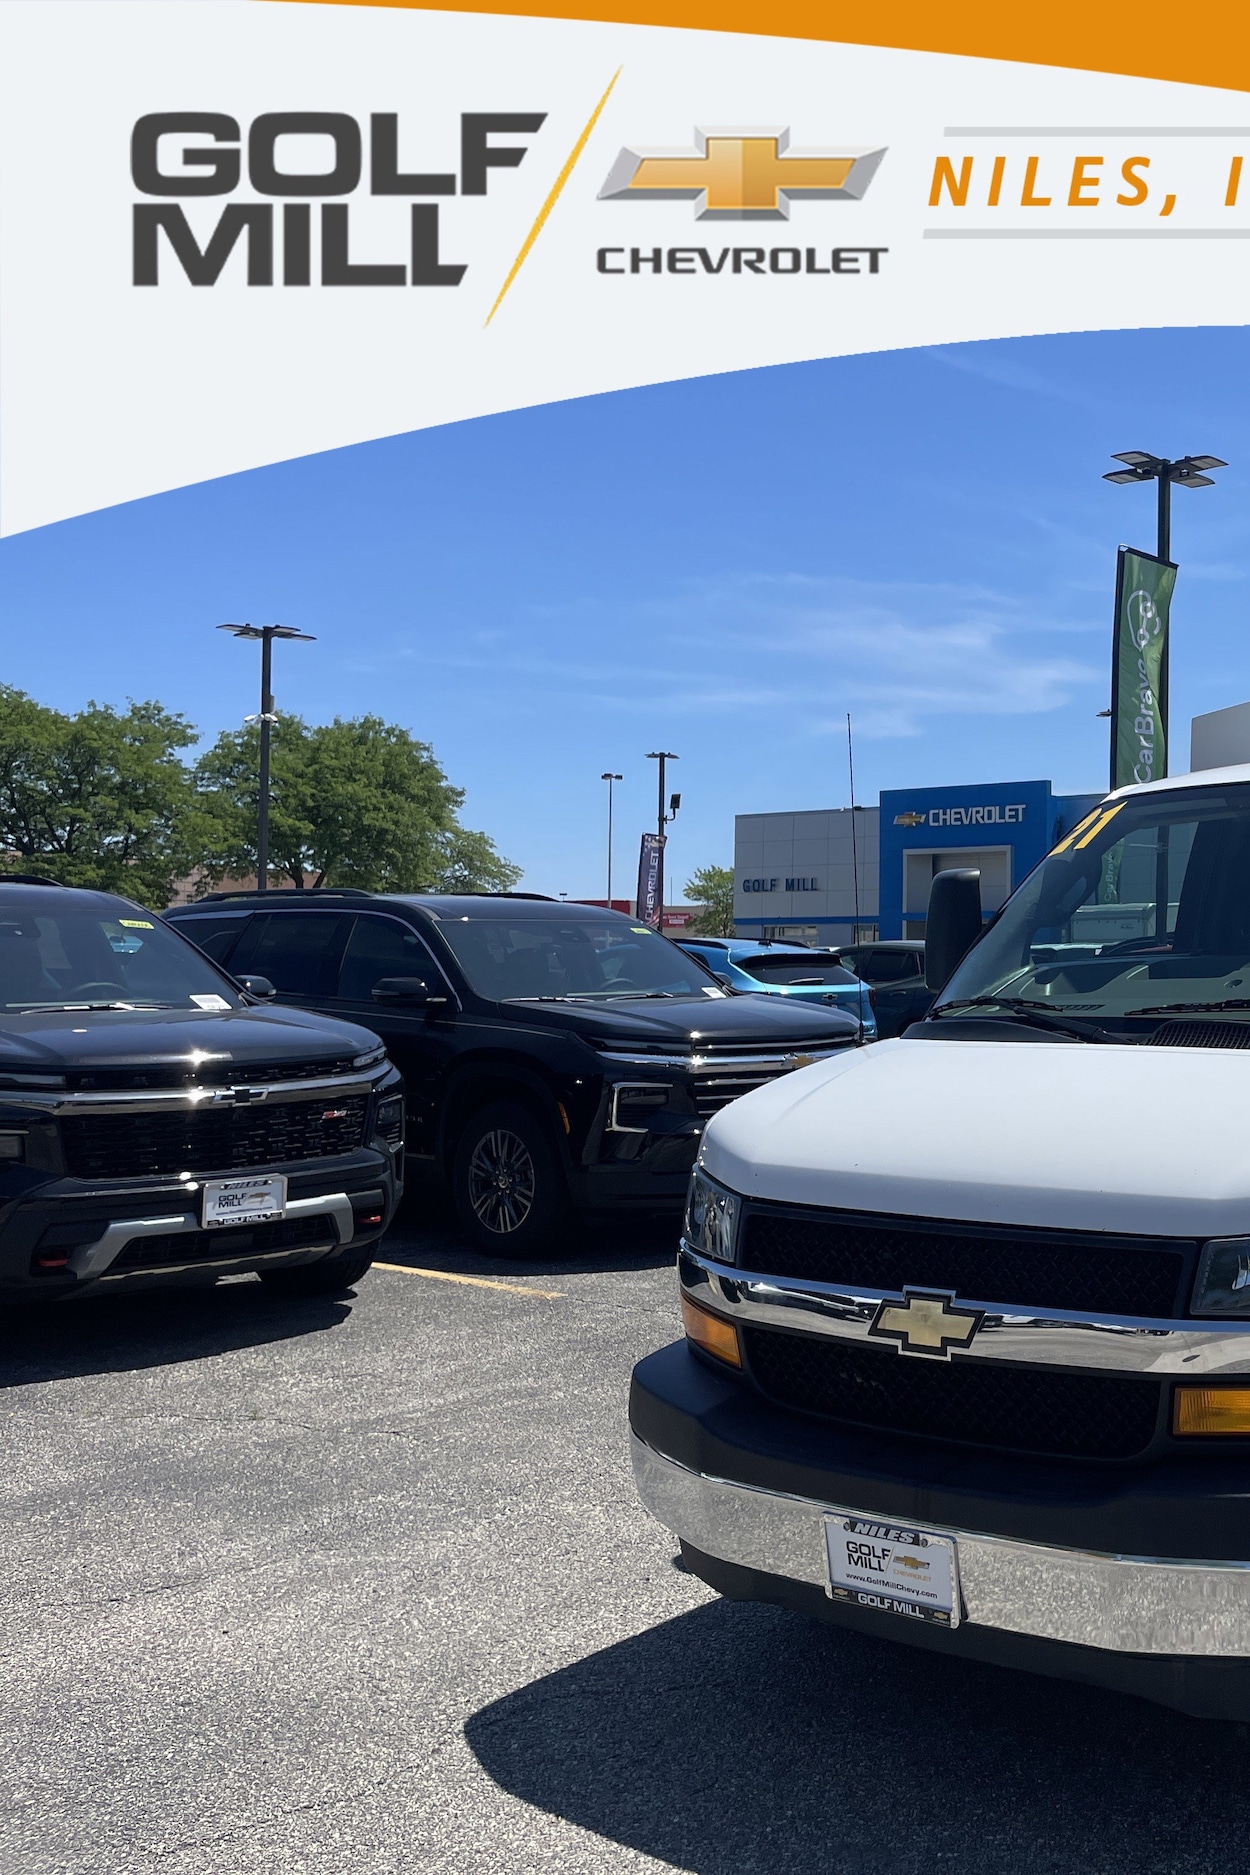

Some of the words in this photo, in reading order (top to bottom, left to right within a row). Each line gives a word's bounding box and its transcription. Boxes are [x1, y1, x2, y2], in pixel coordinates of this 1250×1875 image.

[928, 804, 1027, 827] CHEVROLET
[1046, 800, 1129, 858] 21
[644, 850, 660, 920] CHEVROLET
[742, 879, 777, 893] GOLF
[785, 877, 818, 892] MILL
[218, 1193, 247, 1201] GOLF
[218, 1200, 241, 1208] MILL
[854, 1522, 915, 1544] NILES
[846, 1541, 891, 1560] GOLF
[847, 1553, 885, 1573] MILL
[845, 1572, 938, 1599] www.GolfMillChevy.com
[857, 1592, 892, 1610] GOLF
[893, 1600, 925, 1619] MILL
